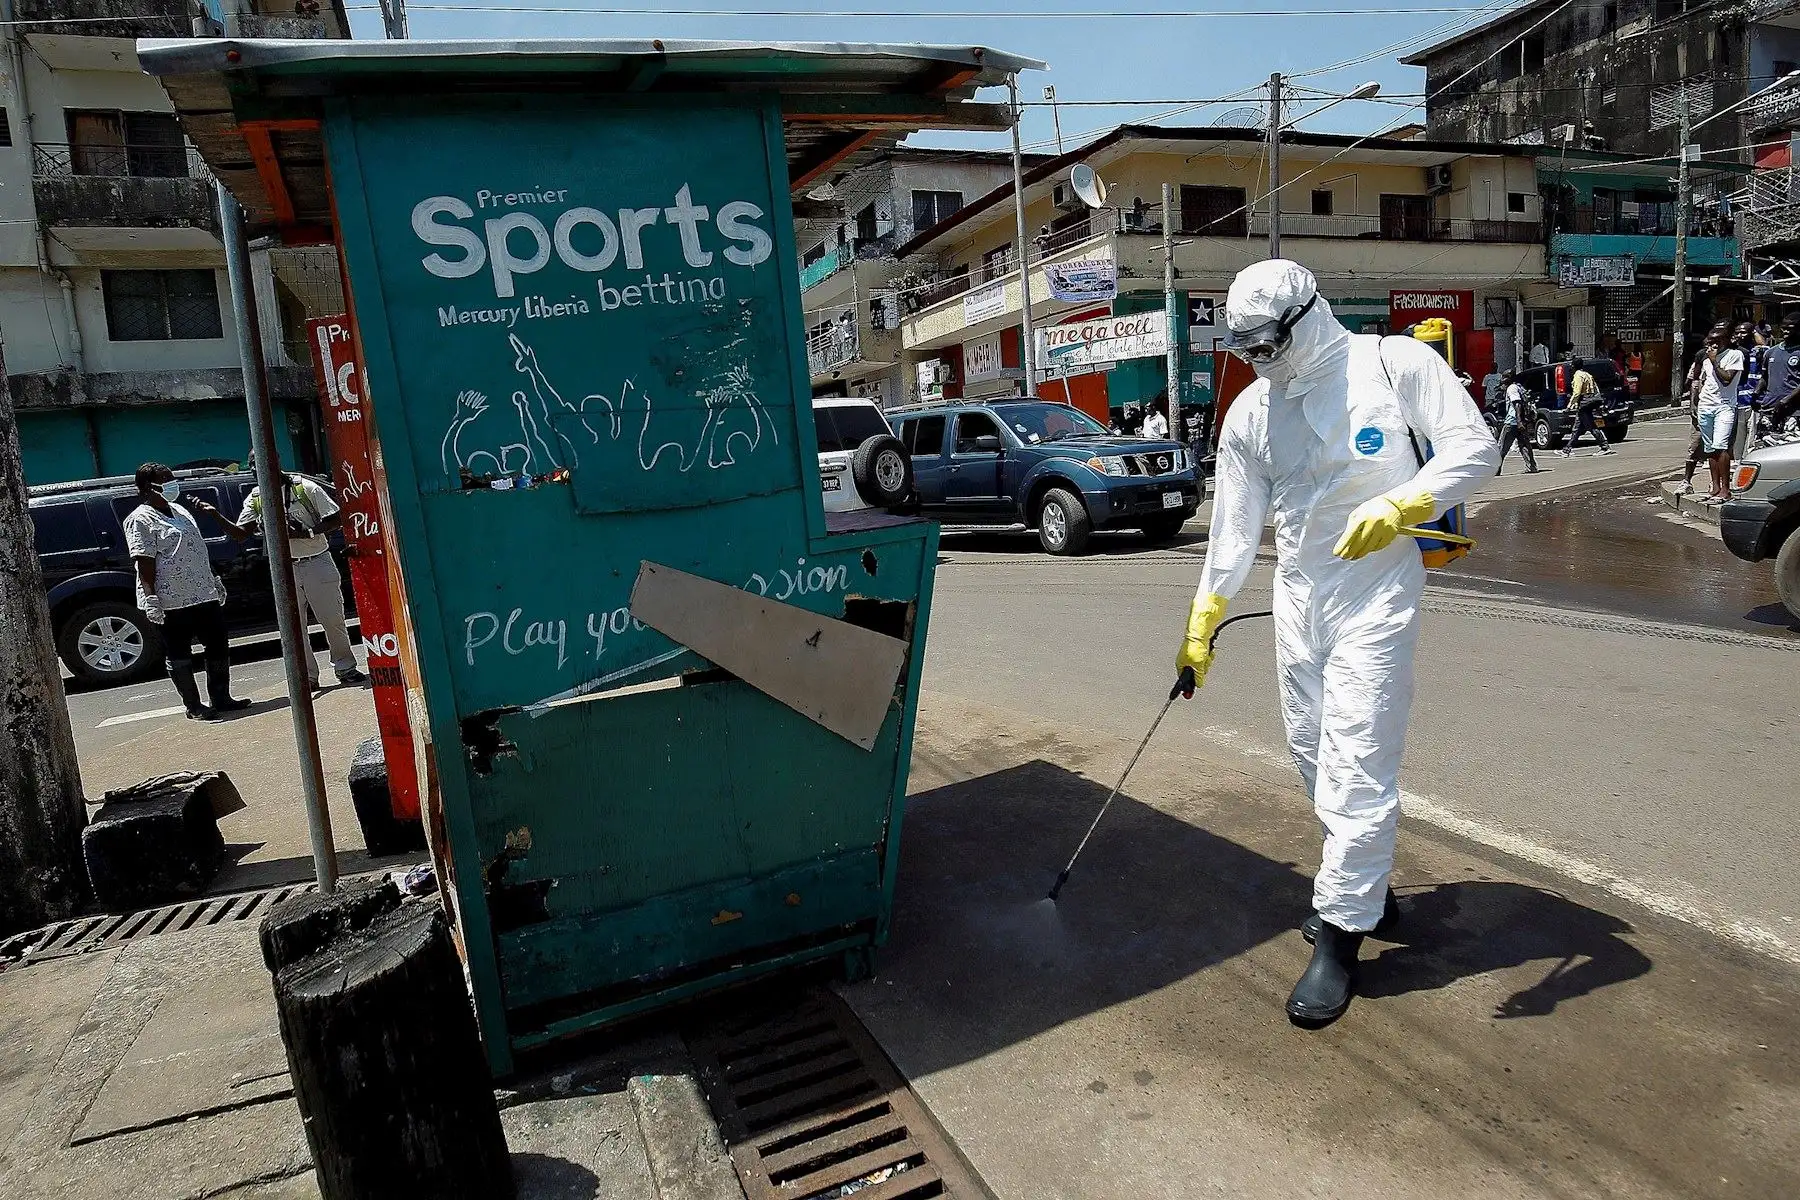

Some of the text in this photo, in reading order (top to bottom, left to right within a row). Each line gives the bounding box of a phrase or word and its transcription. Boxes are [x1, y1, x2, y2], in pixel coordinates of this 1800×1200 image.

[476, 184, 568, 209] Premier
[411, 182, 773, 298] Sports
[1393, 293, 1460, 310] FASHIONISTA!
[438, 304, 520, 328] Mercury
[328, 324, 350, 342] Pr
[464, 607, 569, 670] Play
[732, 557, 852, 600] ssion
